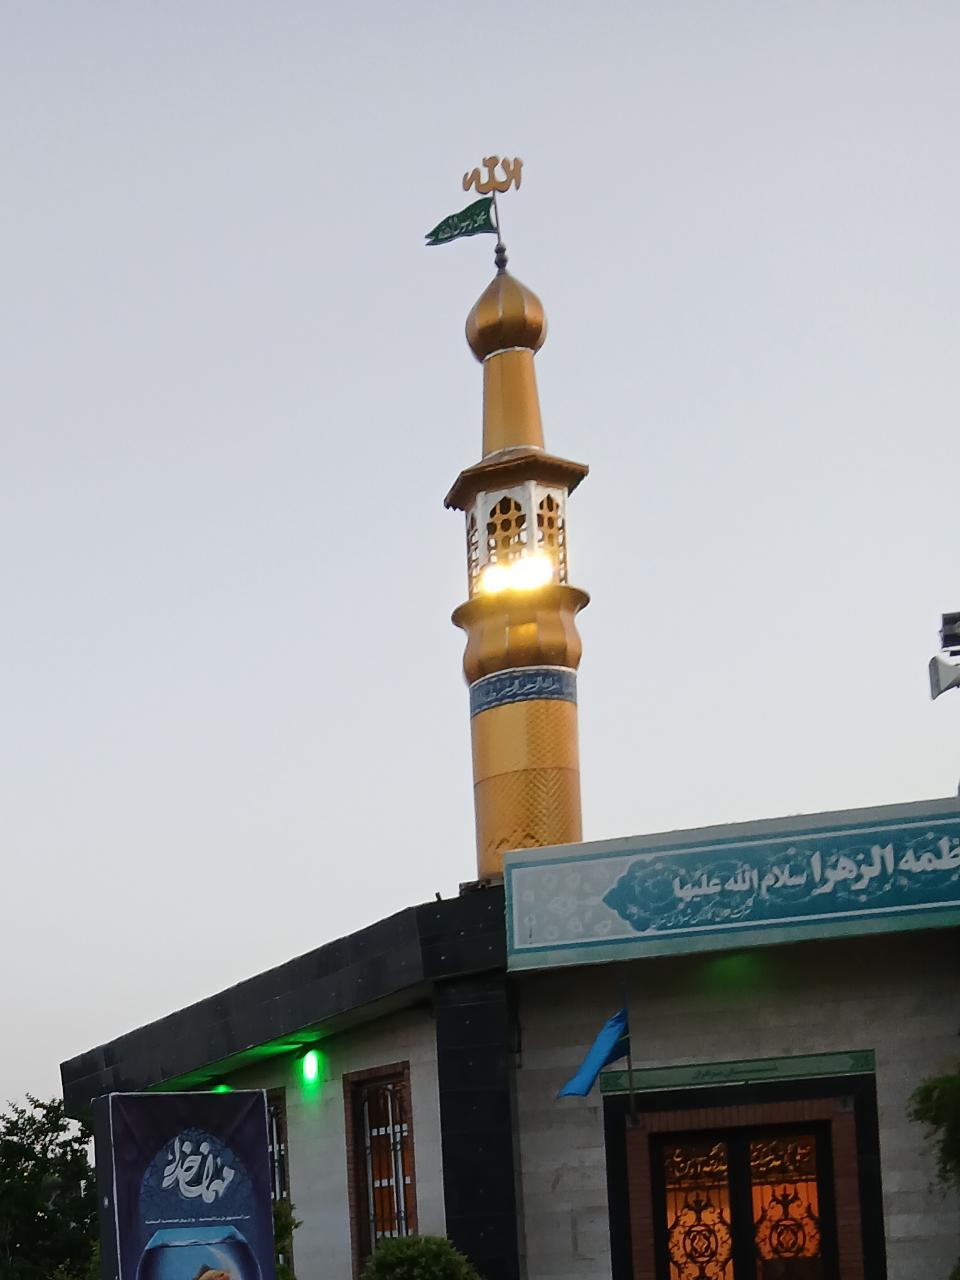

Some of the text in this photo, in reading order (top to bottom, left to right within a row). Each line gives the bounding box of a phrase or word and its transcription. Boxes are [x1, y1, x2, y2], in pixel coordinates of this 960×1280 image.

[463, 156, 524, 195] الله
[898, 836, 960, 873] طمه
[724, 863, 759, 892] الله
[760, 863, 808, 899] سلام
